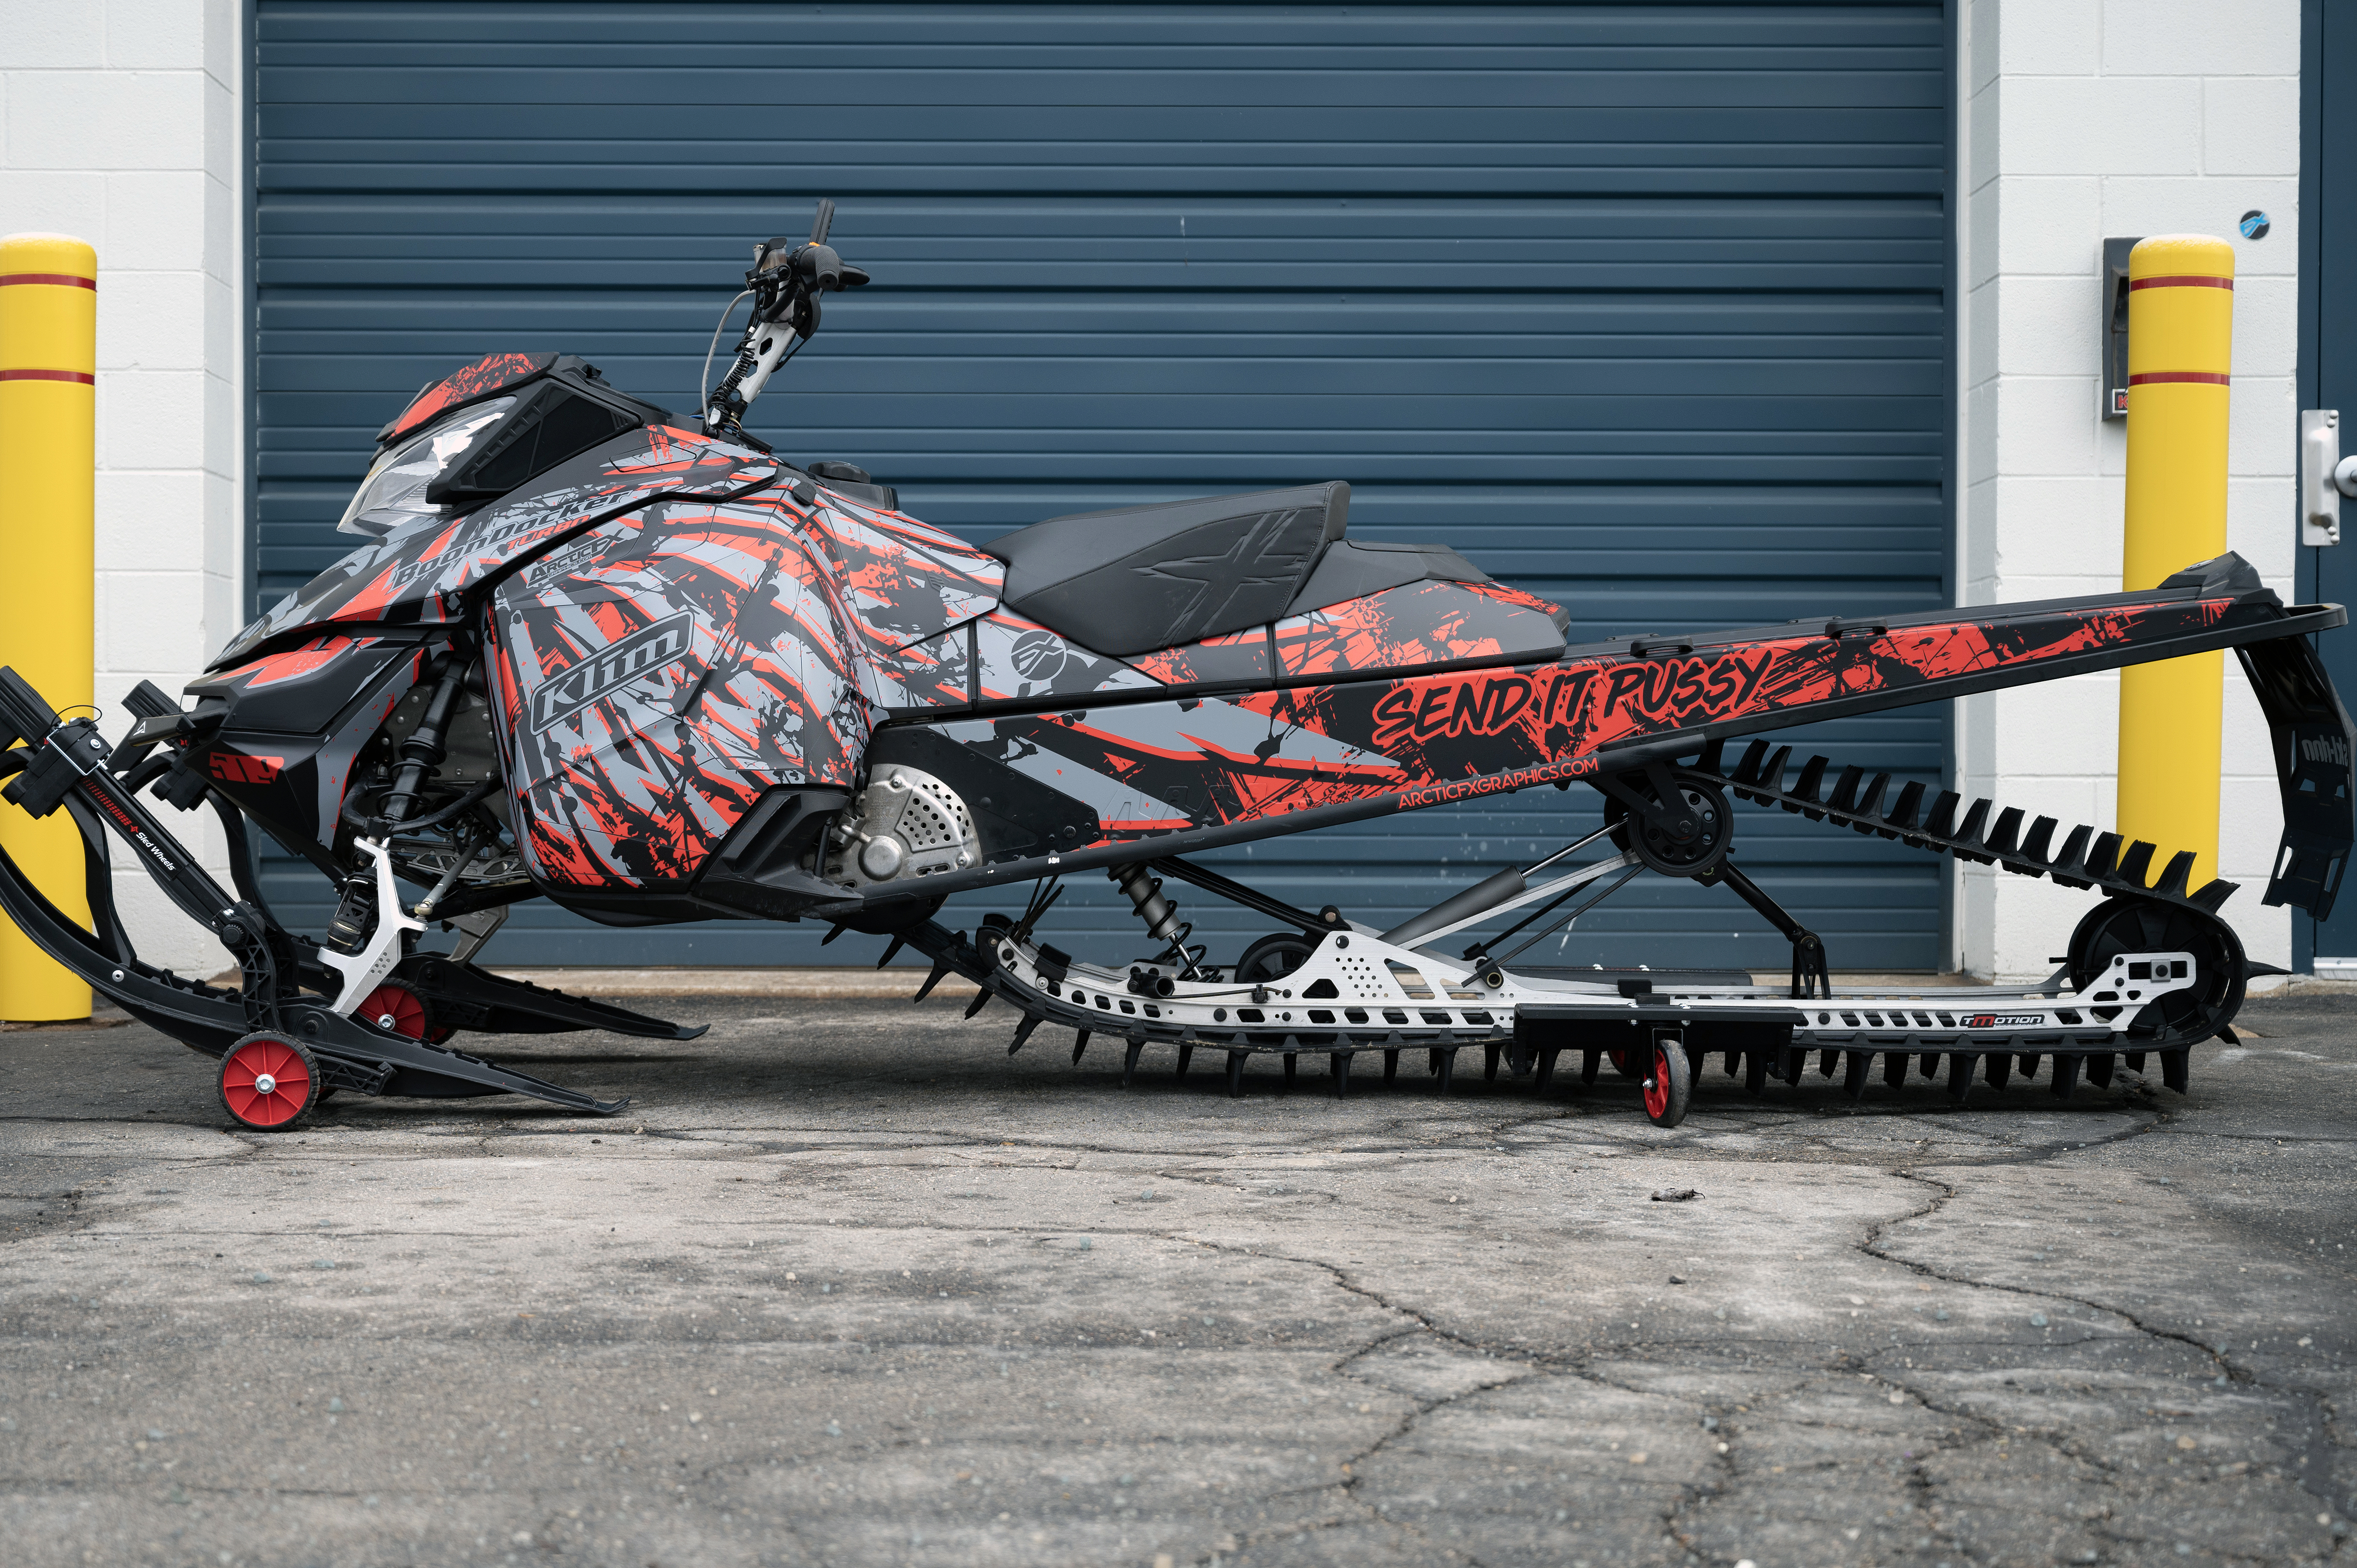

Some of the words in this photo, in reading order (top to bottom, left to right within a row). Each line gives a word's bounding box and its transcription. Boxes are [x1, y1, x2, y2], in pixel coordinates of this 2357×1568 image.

[1376, 676, 1533, 742] SEND
[1544, 669, 1600, 725] IT
[1398, 757, 1599, 809] ARCTICFXGRAPHICS.COM
[136, 832, 154, 848] Sled
[151, 846, 175, 870] Wheels
